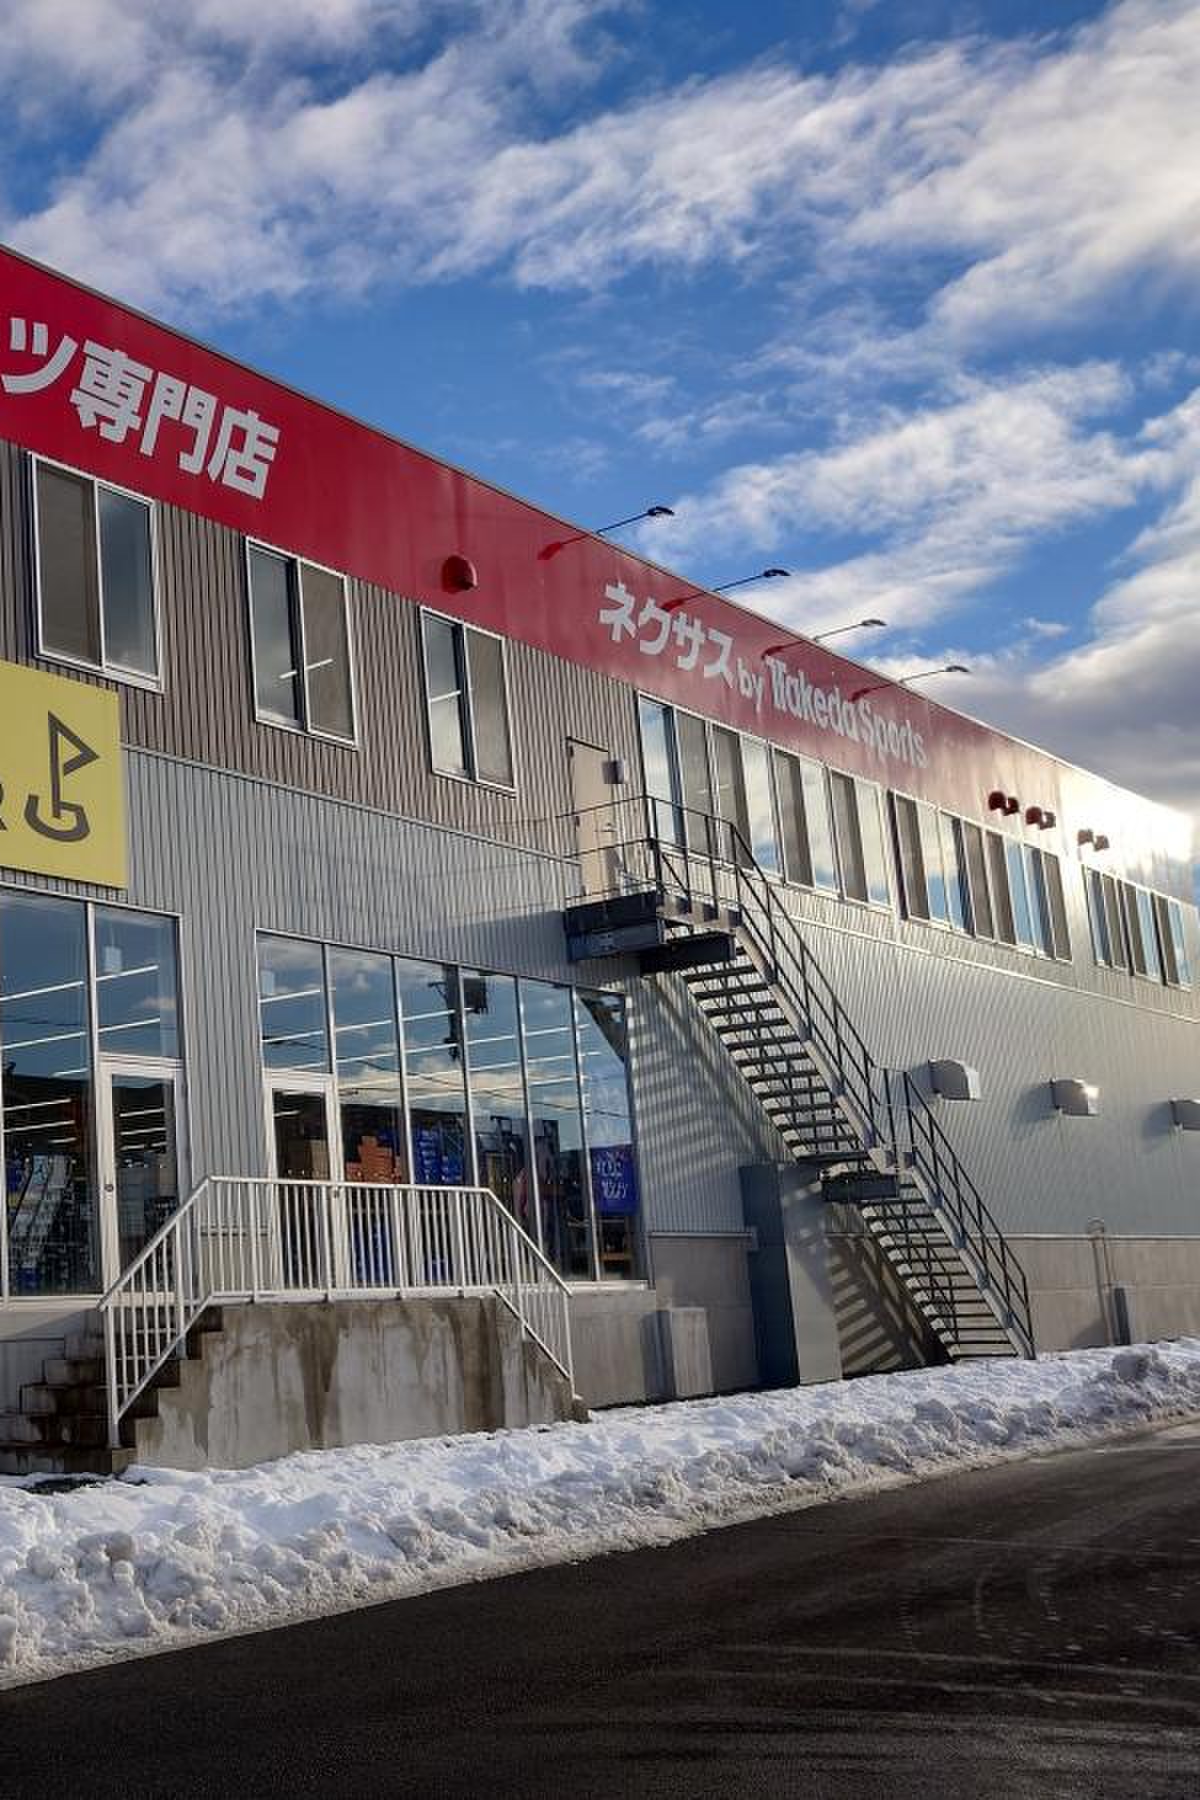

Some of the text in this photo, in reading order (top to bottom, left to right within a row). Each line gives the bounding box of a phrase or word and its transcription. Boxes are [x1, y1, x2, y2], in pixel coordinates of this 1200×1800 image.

[599, 580, 928, 768] ネクサス by Takeda Sports
